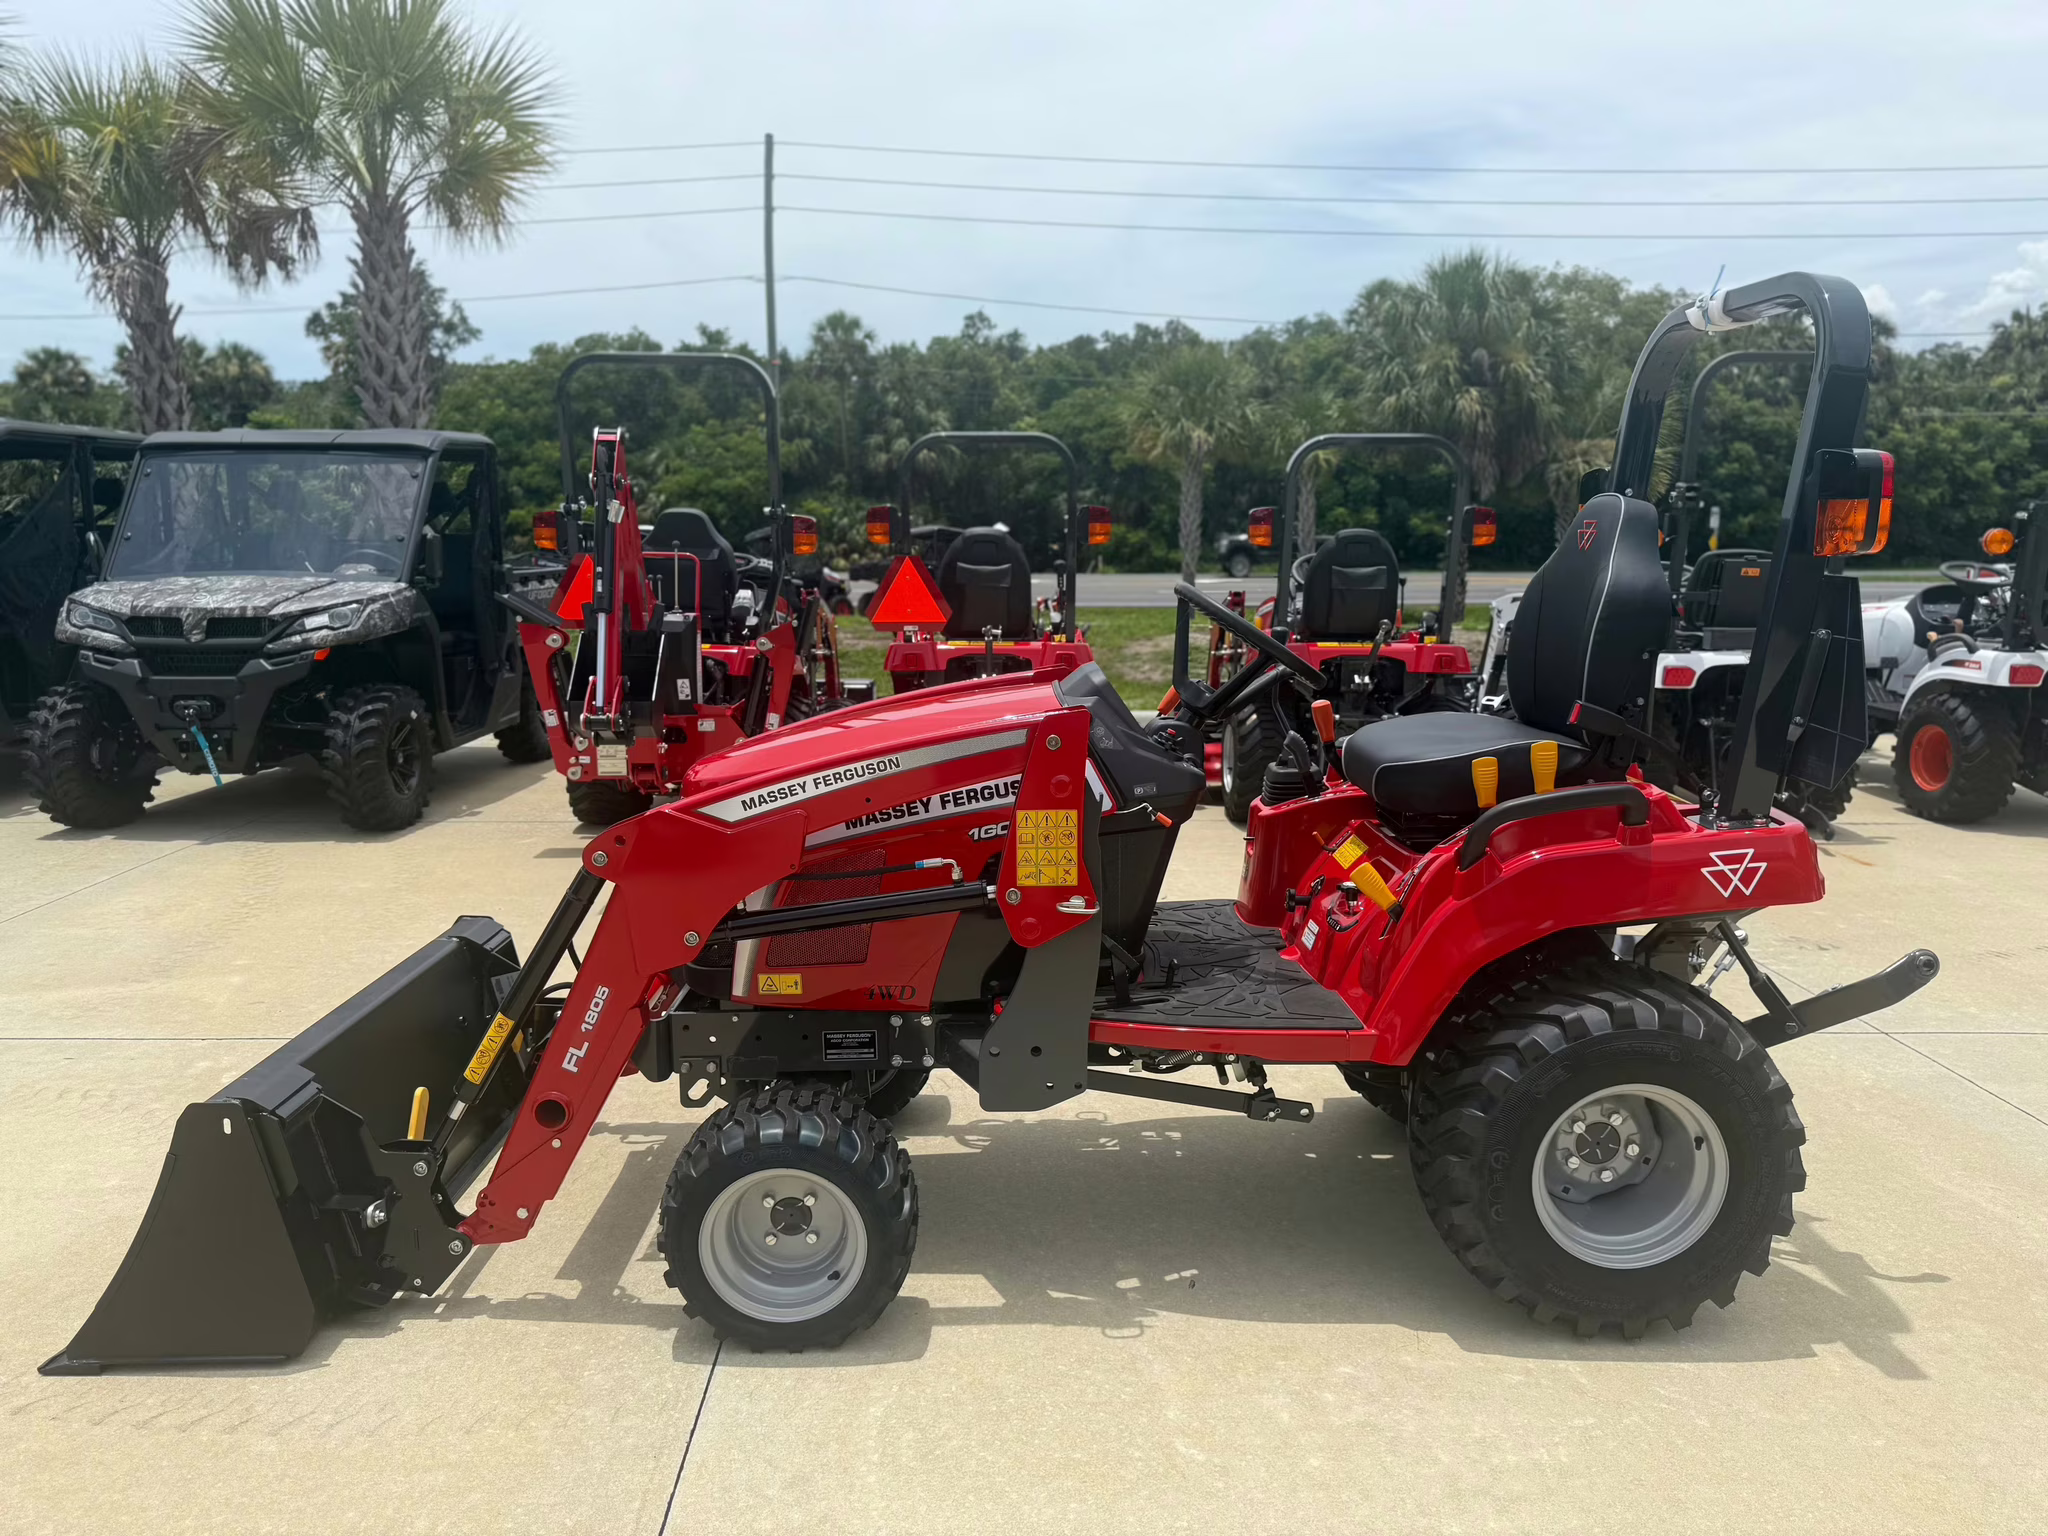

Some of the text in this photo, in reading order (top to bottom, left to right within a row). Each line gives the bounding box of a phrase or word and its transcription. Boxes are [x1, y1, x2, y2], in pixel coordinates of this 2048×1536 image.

[741, 756, 901, 811] MASSEY FERGUSON
[845, 797, 932, 830] MASSEY
[864, 984, 917, 1000] 4WD
[562, 985, 610, 1073] FL 1805
